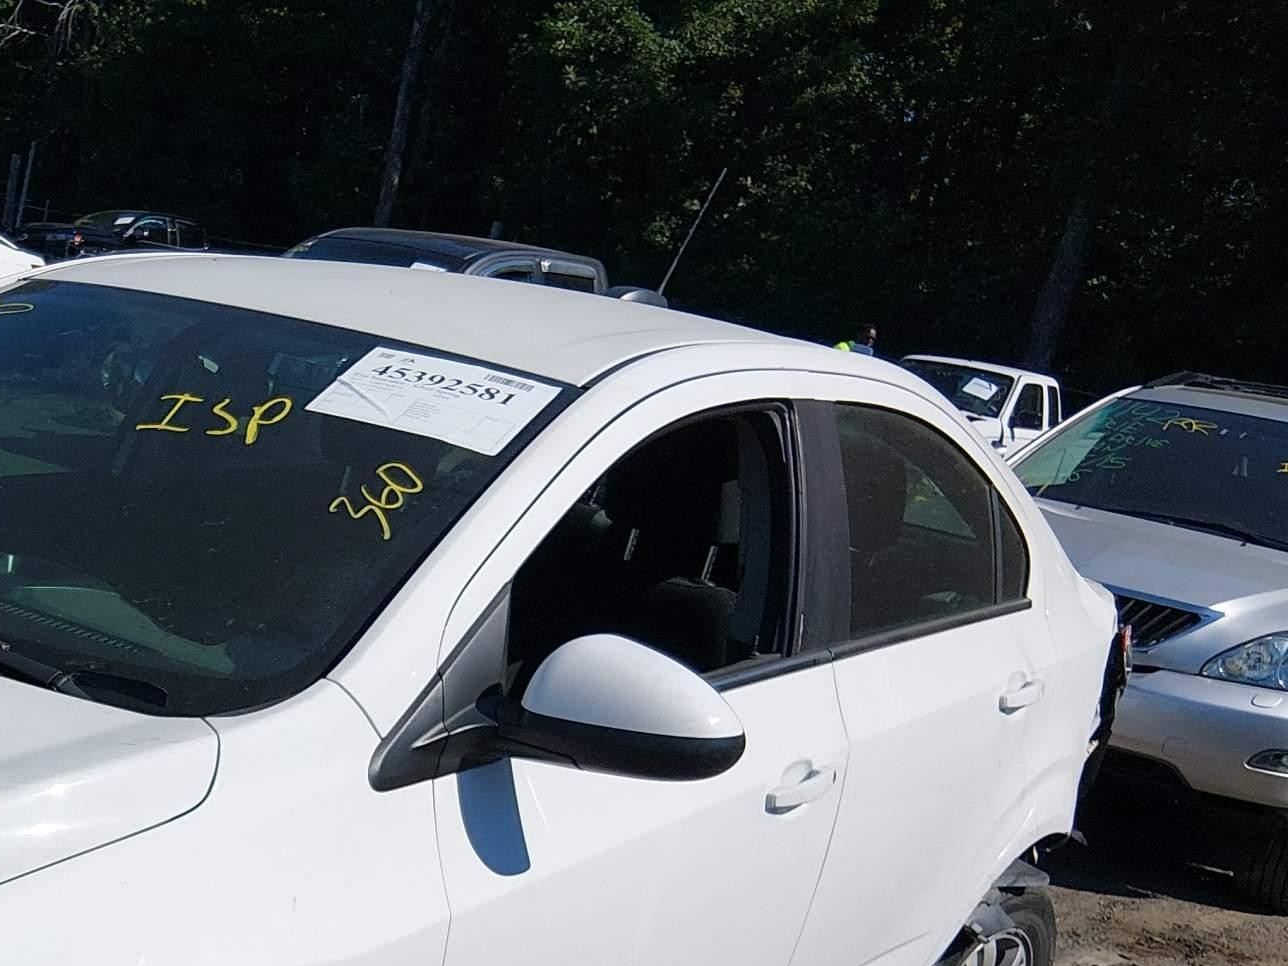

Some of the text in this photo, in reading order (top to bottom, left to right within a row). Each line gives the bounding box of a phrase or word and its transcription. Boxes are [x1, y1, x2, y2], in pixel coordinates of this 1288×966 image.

[371, 364, 517, 406] 45392581
[135, 393, 293, 445] ISP
[328, 461, 424, 541] 360
